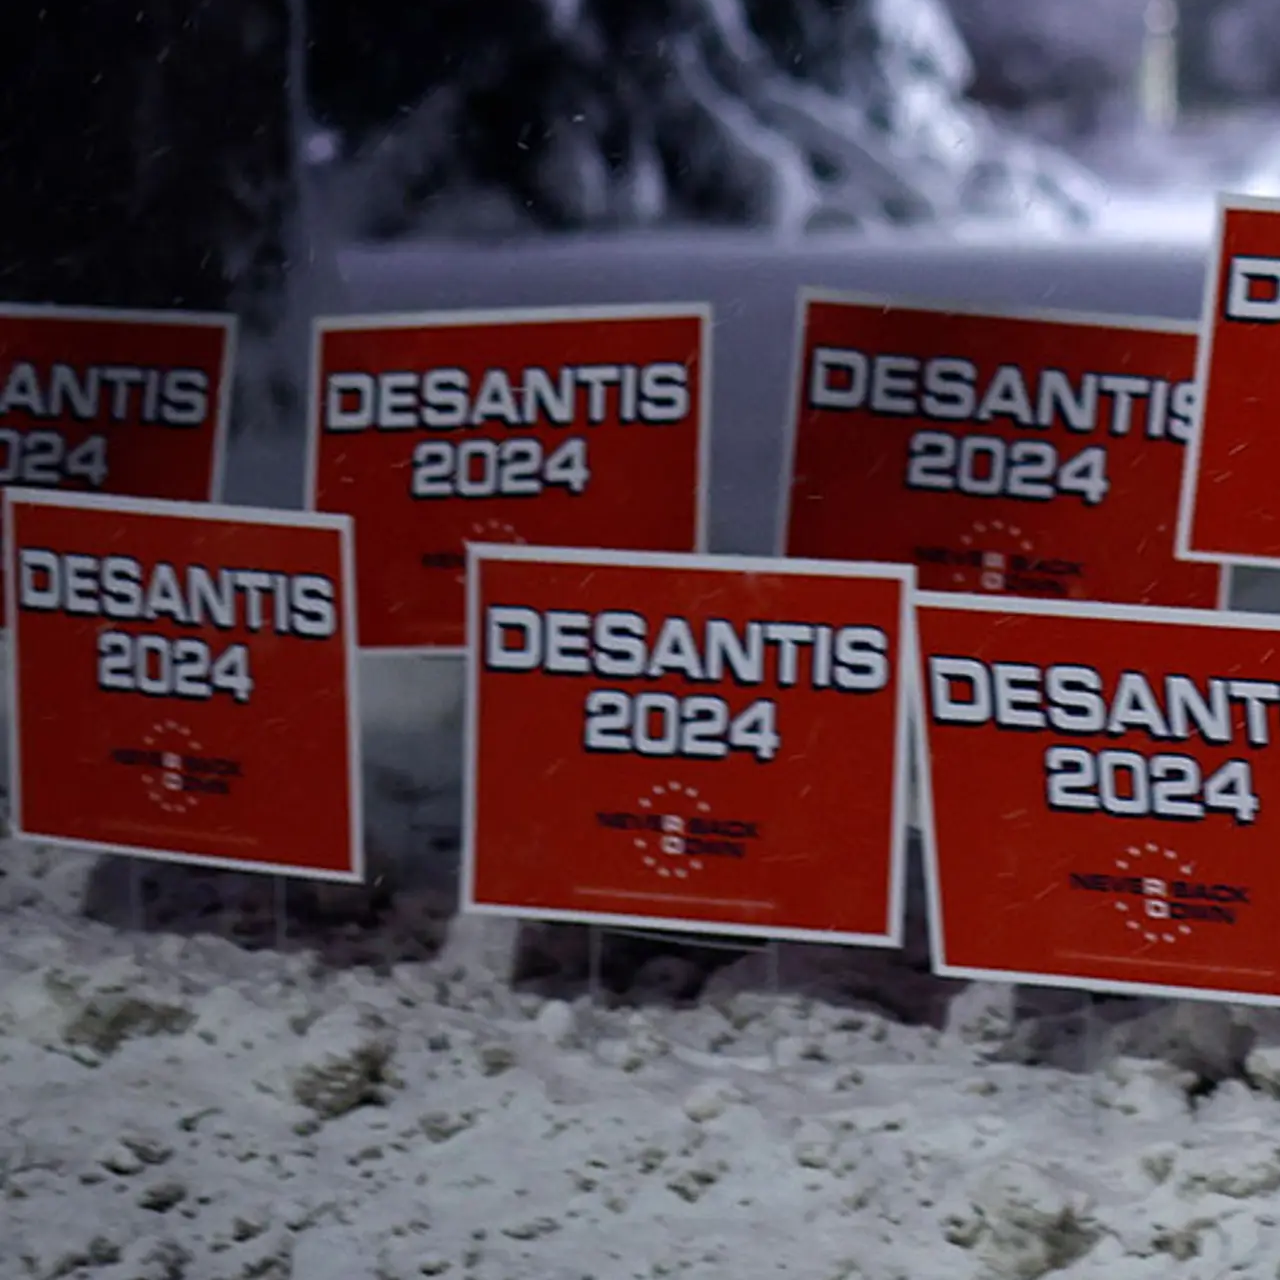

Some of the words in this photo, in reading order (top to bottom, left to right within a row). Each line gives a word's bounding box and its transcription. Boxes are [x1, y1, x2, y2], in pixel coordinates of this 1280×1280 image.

[326, 362, 690, 430] DESANTIS
[811, 347, 1198, 442] DESANTIS
[412, 437, 590, 497] 2024
[908, 431, 1111, 504] 2024
[19, 548, 337, 637] DESANTIS
[97, 631, 254, 701] 2024
[487, 606, 889, 690] DESANTIS
[584, 690, 780, 760] 2024
[1045, 746, 1260, 822] 2024
[1172, 881, 1249, 903] BACK
